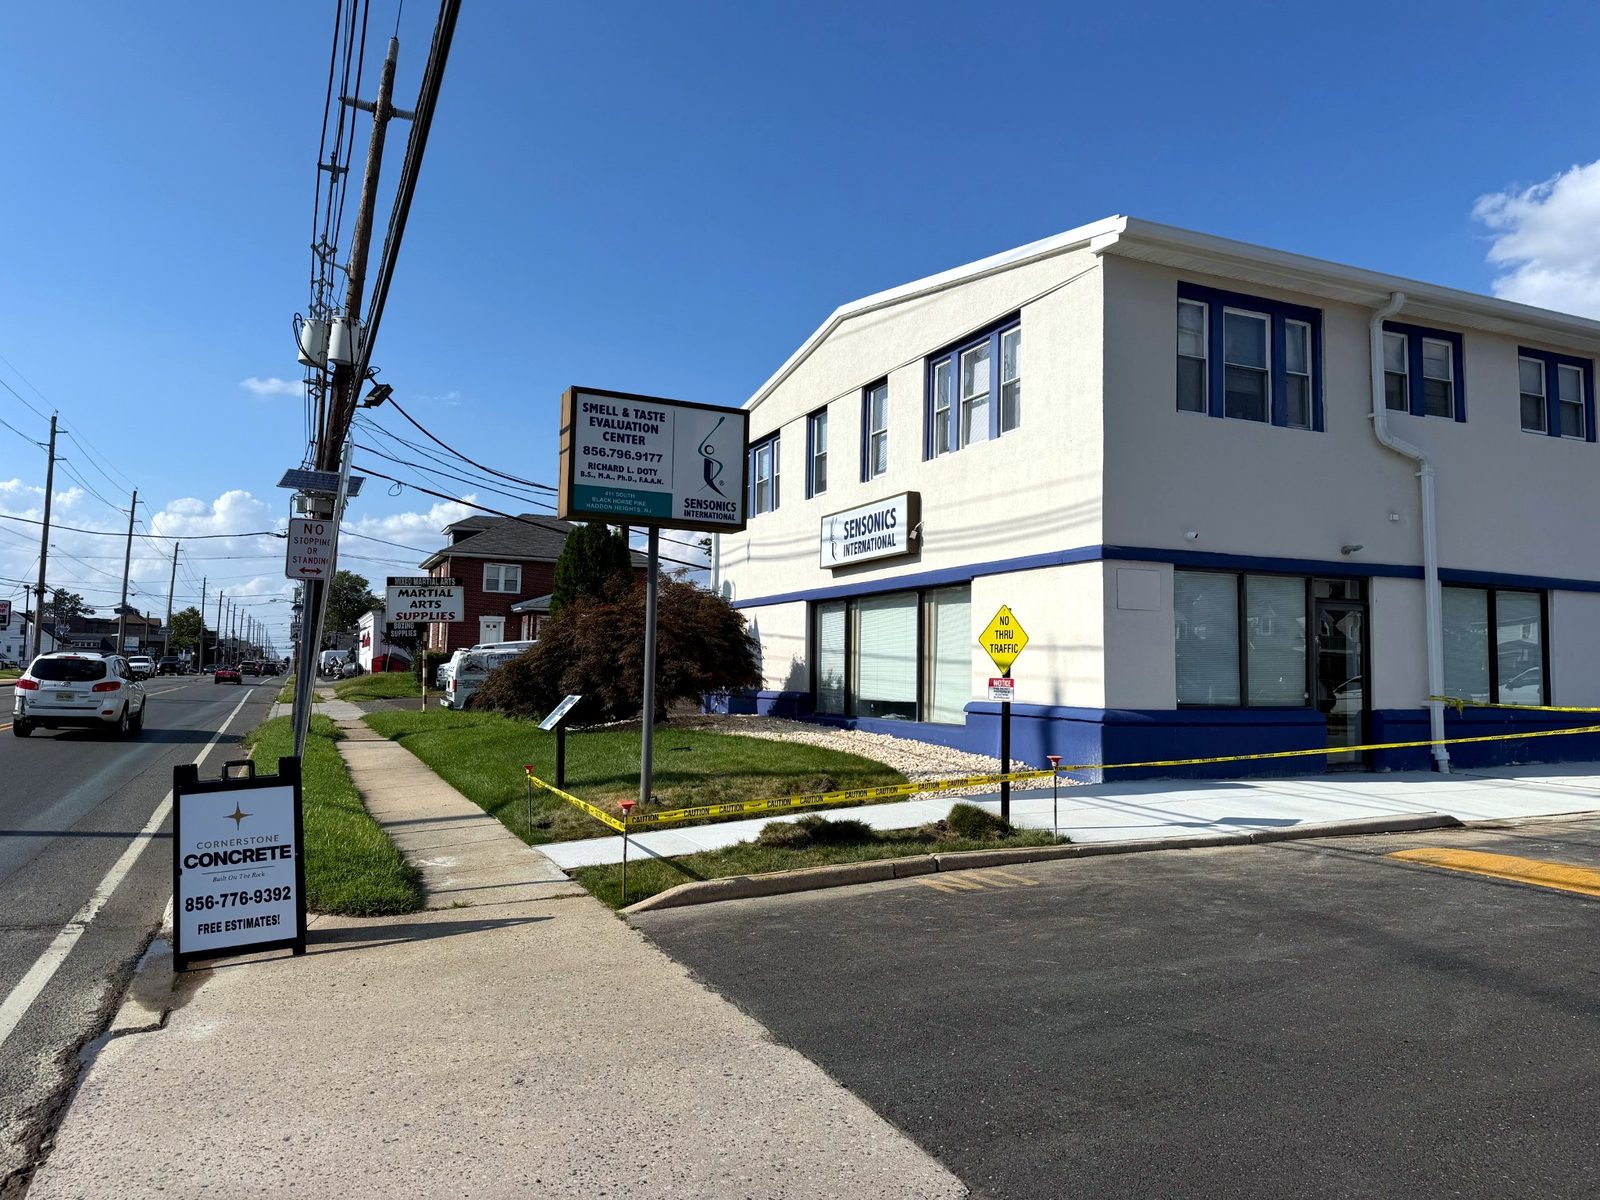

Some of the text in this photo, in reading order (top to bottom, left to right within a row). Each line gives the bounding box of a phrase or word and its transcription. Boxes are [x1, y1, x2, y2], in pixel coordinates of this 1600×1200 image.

[583, 403, 665, 422] SMELL & TASTE
[590, 417, 659, 434] EVALUATION
[603, 432, 645, 445] CENTER
[583, 446, 663, 463] 856.796.9177
[588, 462, 657, 476] RICHARD L. DOTY
[581, 471, 664, 485] B.S., M.A., Ph.D., F.A.A.N.
[684, 498, 736, 512] SENSONICS
[684, 510, 736, 520] INTERNATIONAL
[304, 524, 324, 534] NO
[844, 508, 896, 540] SENSONICS
[307, 547, 318, 555] OR
[844, 533, 896, 557] INTERNATIONAL
[292, 556, 329, 565] STANDIN
[398, 589, 453, 597] MARTIAL
[396, 612, 455, 620] SUPPLIES
[1000, 616, 1009, 625] NO
[995, 630, 1013, 639] THRU
[990, 644, 1018, 653] TRAFFIC
[632, 814, 659, 823] CAUTION
[684, 808, 709, 817] CAUTION
[719, 804, 744, 813] CAUTION
[767, 799, 791, 808] CAUTION
[800, 795, 823, 804] CAUTION
[845, 790, 867, 799] CAUTION
[876, 787, 898, 795] CAUTION
[918, 782, 940, 790] CAUTION
[947, 779, 968, 787] CAUTION
[197, 835, 279, 849] CORNERSTONE
[184, 845, 292, 869] CONCRETE
[212, 875, 226, 883] Built
[185, 886, 291, 912] 856-776-9392
[198, 915, 280, 935] FREE ESTIMATES!
